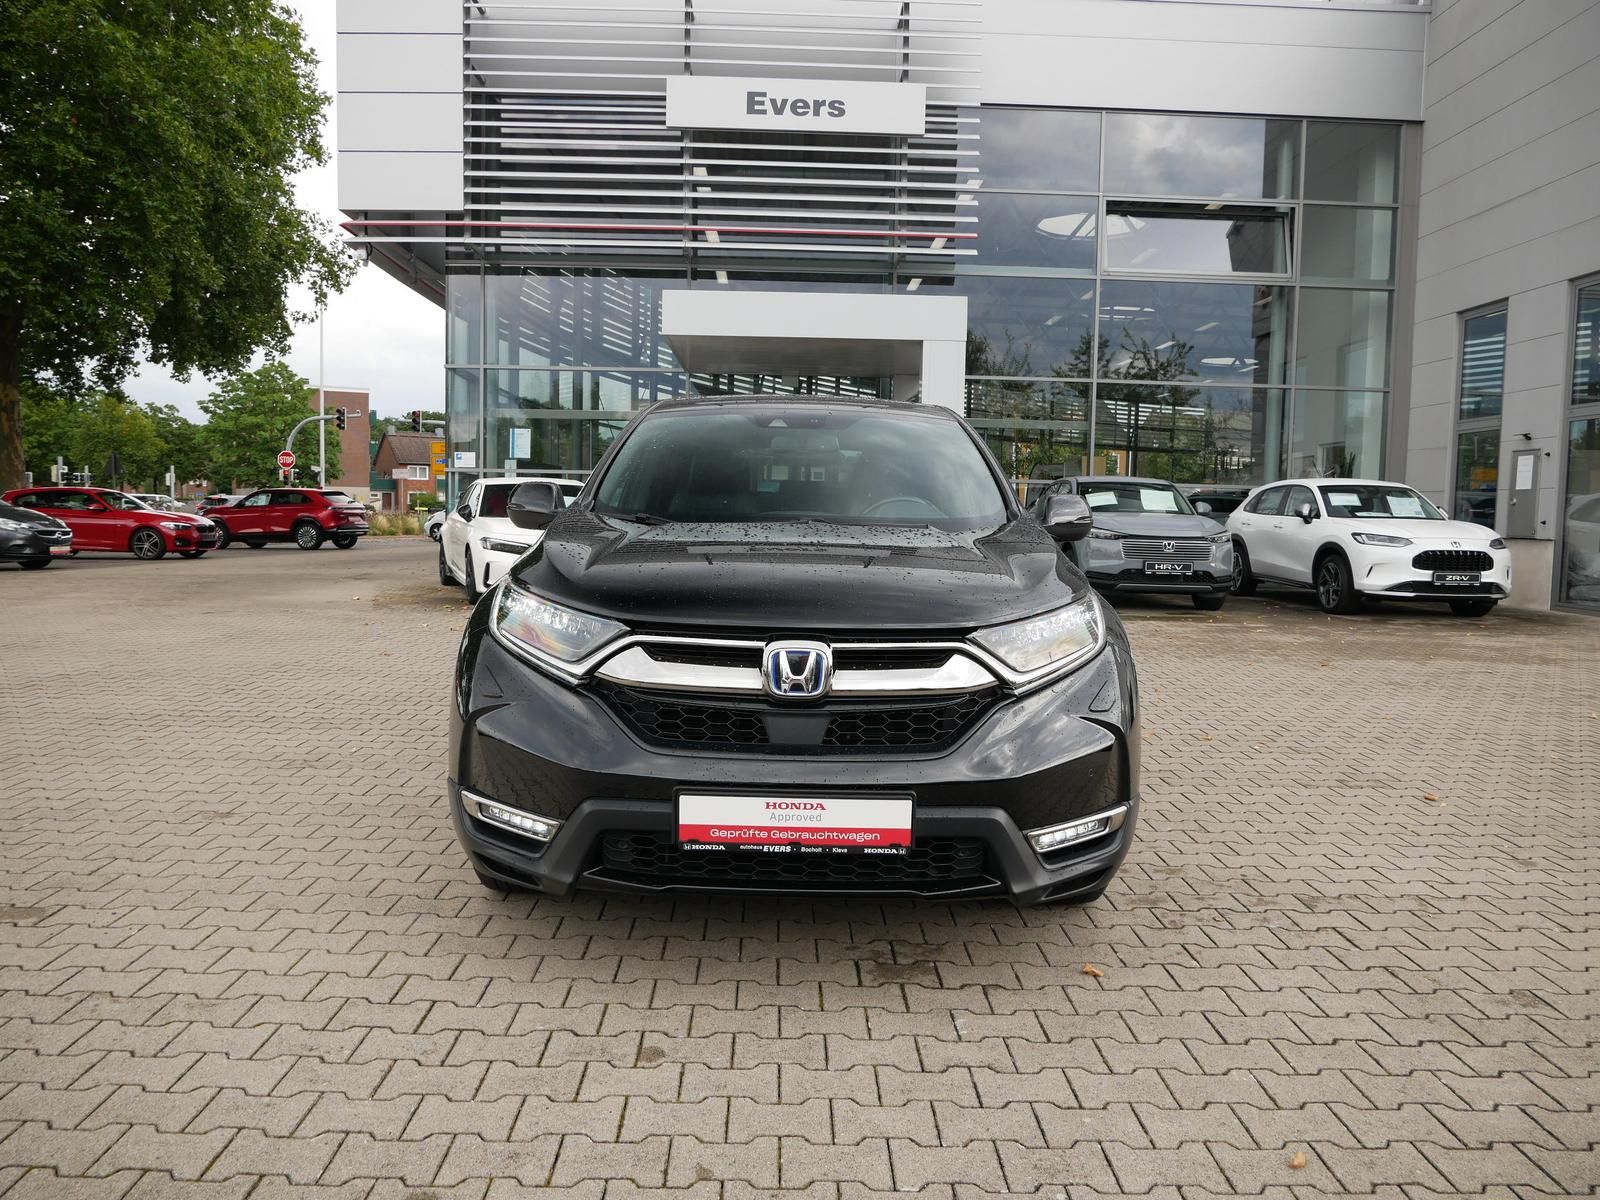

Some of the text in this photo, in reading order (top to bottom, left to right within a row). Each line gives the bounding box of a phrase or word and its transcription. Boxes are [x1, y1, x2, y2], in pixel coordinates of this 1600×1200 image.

[746, 91, 846, 118] Evers
[279, 456, 294, 464] STOP
[1155, 563, 1184, 571] HR-V
[765, 802, 827, 811] HONDA
[769, 811, 823, 823] Approved
[710, 828, 881, 843] Geprüfte Gebrauchtwagen
[691, 843, 726, 851] HONDA
[763, 845, 792, 853] EVERS
